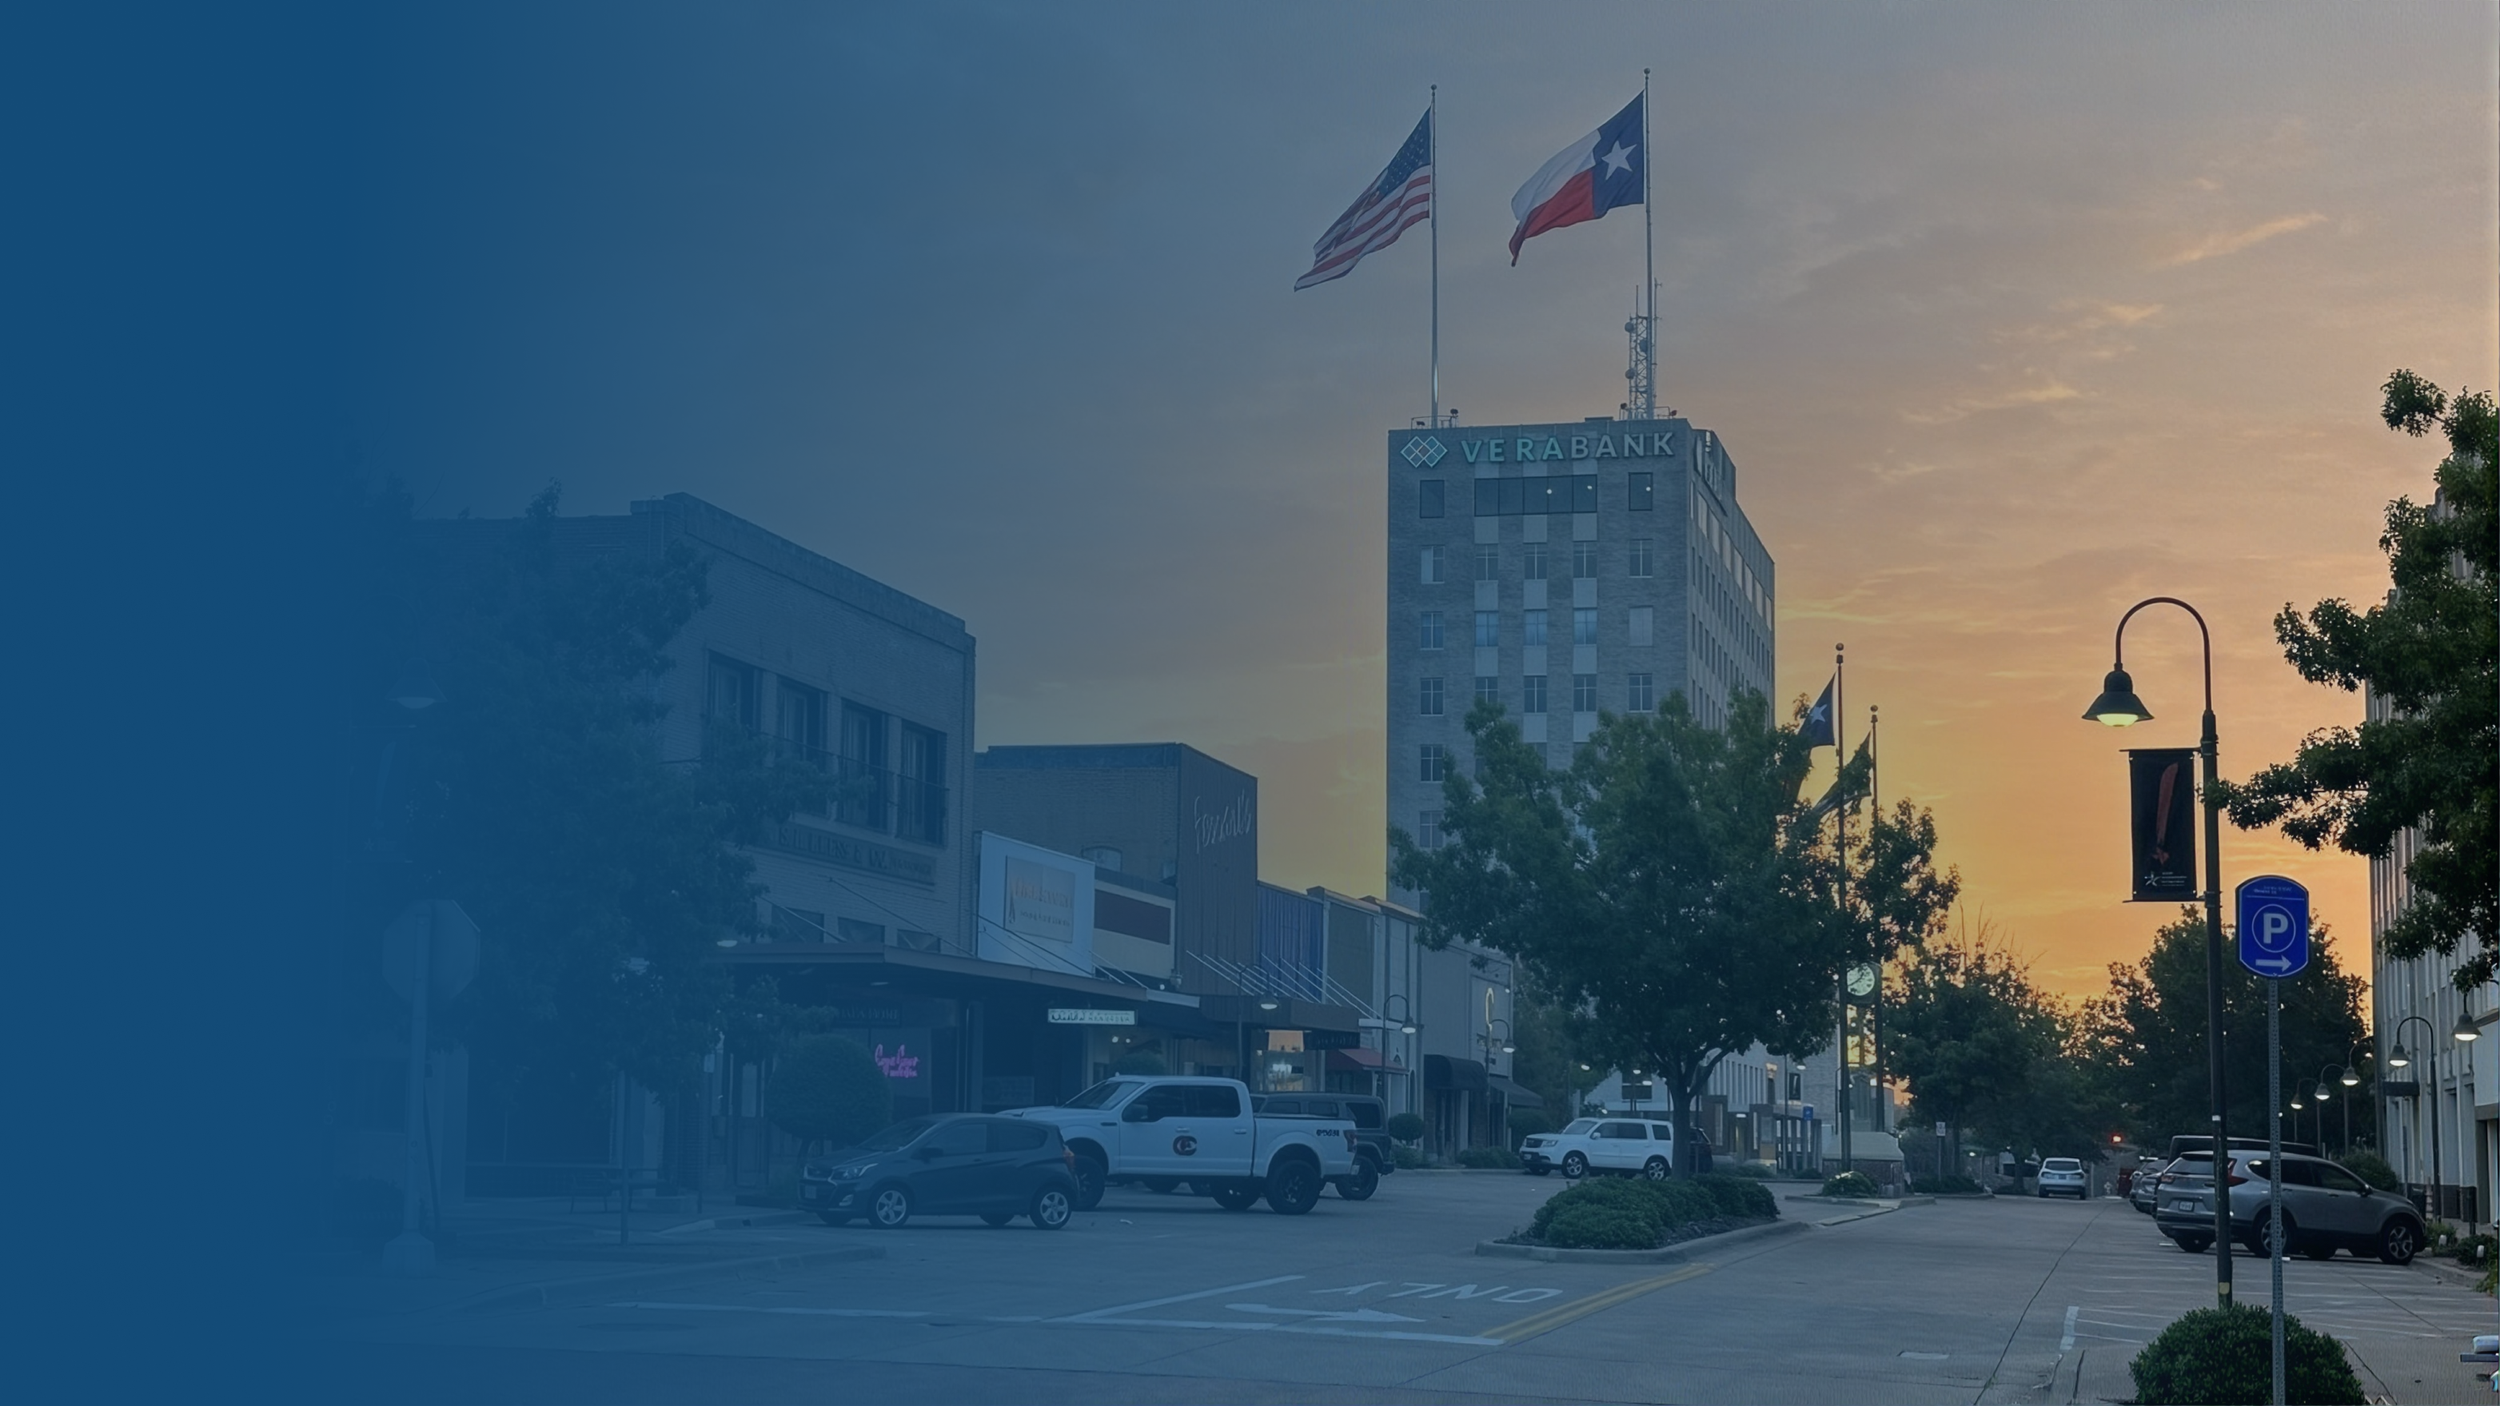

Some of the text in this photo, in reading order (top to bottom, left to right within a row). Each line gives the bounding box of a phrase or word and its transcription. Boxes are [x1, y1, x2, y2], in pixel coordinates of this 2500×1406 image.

[1461, 432, 1674, 463] VERABANK
[2263, 912, 2289, 944] P
[1308, 1280, 1563, 1304] ONLY
